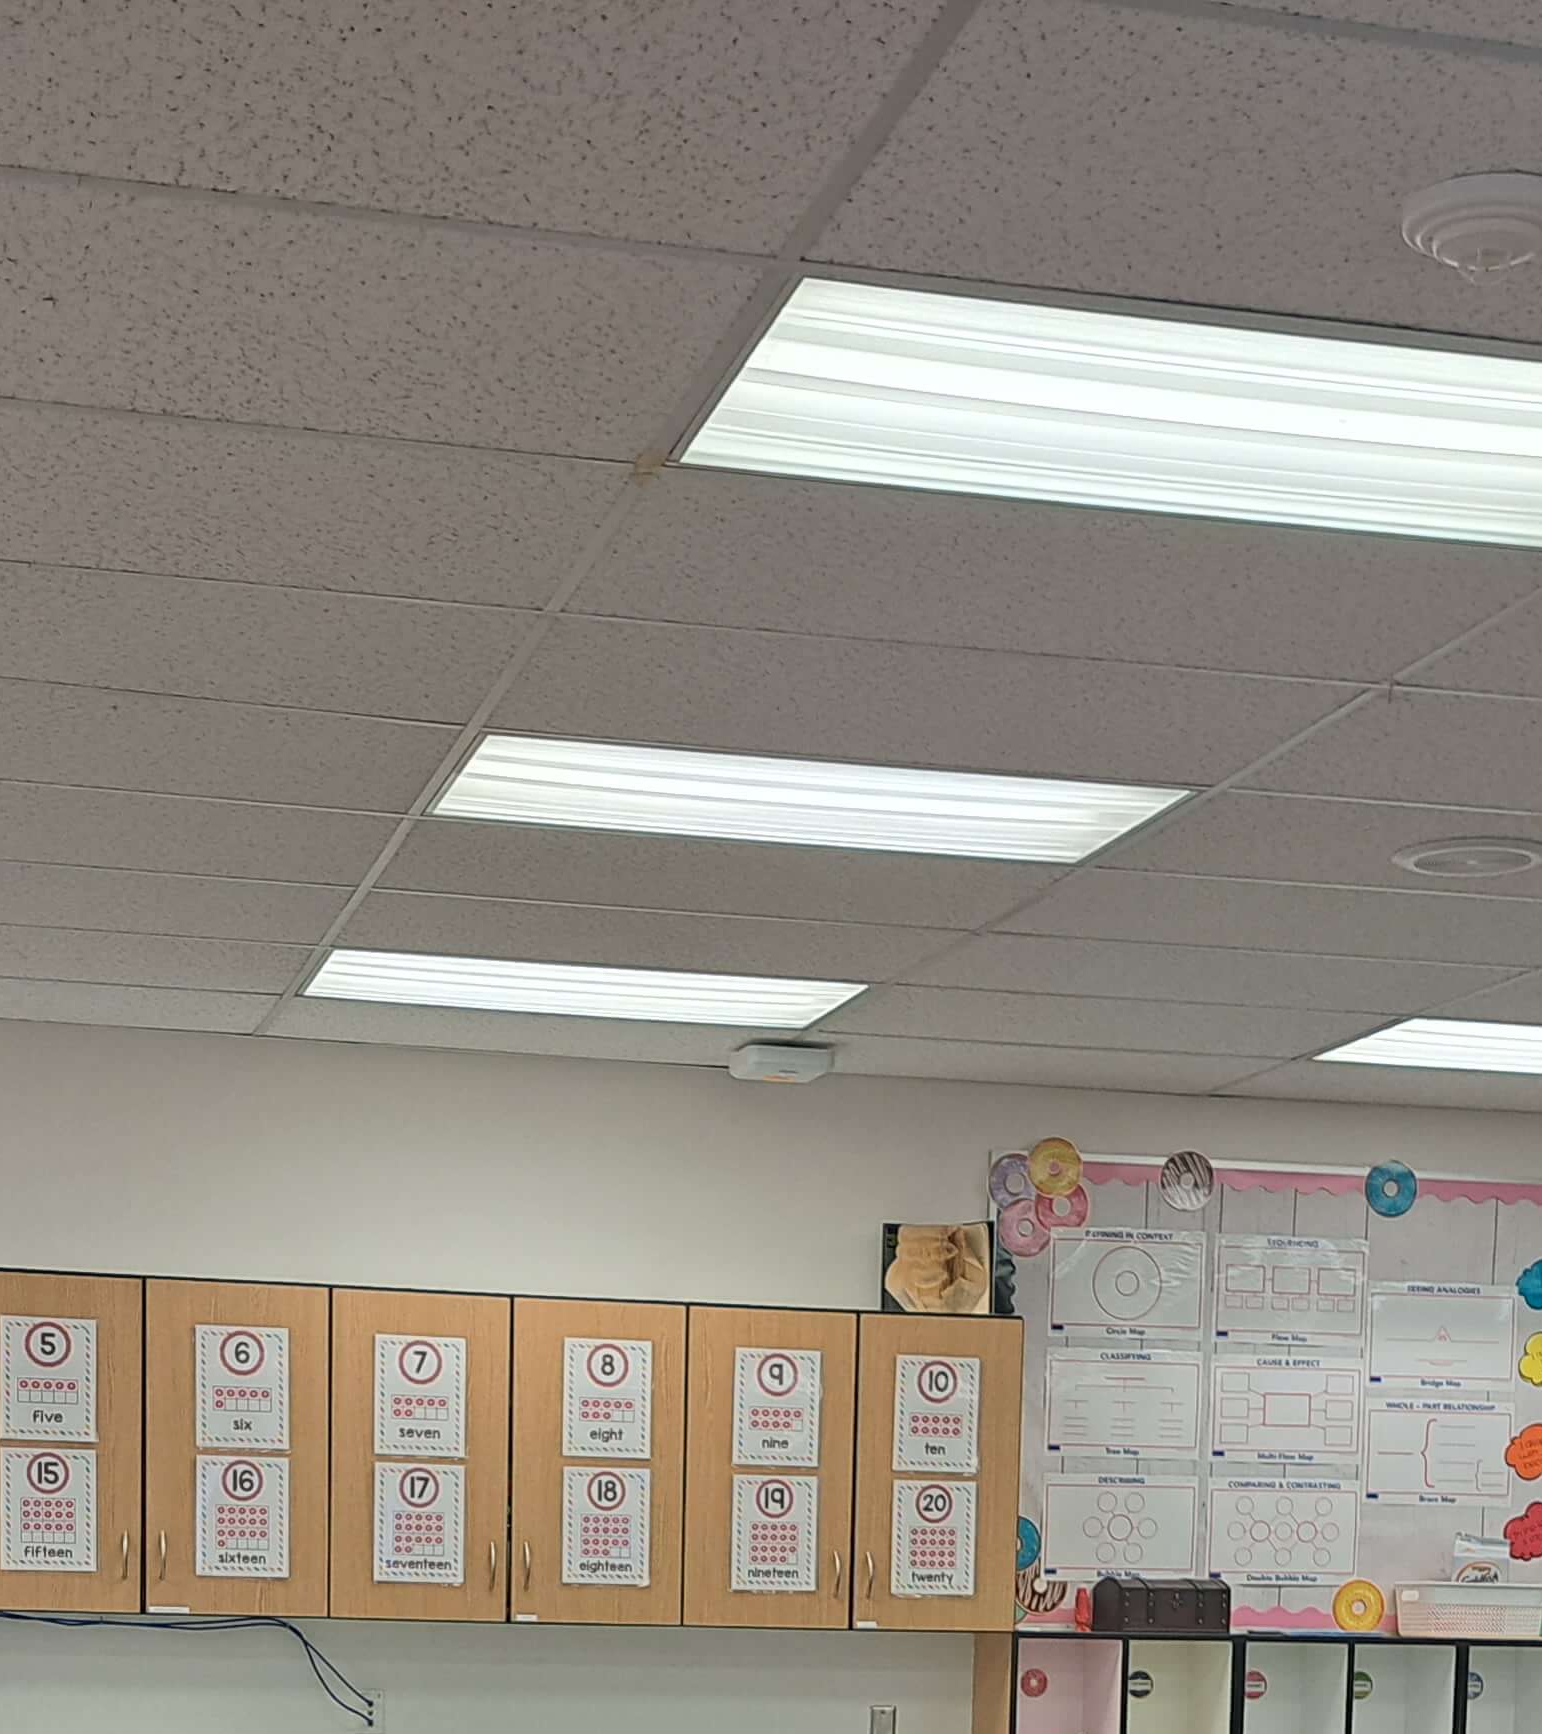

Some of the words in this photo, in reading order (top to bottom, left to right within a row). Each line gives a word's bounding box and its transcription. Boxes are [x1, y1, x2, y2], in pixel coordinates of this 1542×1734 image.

[1137, 1233, 1173, 1241] CONTEXT
[1129, 1328, 1146, 1336] Map
[40, 1332, 57, 1356] 5
[234, 1342, 250, 1364] 6
[1100, 1353, 1151, 1361] CLASSIFYING
[413, 1351, 427, 1374] 7
[601, 1354, 615, 1376] 8
[1294, 1360, 1320, 1368] EFFECT
[769, 1364, 784, 1386] 9
[928, 1371, 950, 1393] 10
[1422, 1403, 1441, 1411] PART
[32, 1410, 64, 1424] five
[233, 1418, 252, 1431] six
[398, 1427, 440, 1440] seven
[589, 1428, 624, 1443] eight
[761, 1438, 789, 1451] nine
[924, 1442, 946, 1457] ten
[37, 1462, 59, 1485] 15
[231, 1469, 254, 1492] 16
[409, 1476, 430, 1498] 17
[597, 1481, 617, 1503] 18
[1228, 1481, 1276, 1489] COMPARING
[1287, 1482, 1341, 1490] CONTRASTING
[764, 1488, 785, 1510] 19
[922, 1494, 946, 1514] 20
[24, 1546, 73, 1560] fifteen
[218, 1551, 266, 1565] sixteen
[385, 1557, 452, 1571] seventeen
[579, 1560, 633, 1575] eighteen
[747, 1567, 799, 1581] nineteen
[911, 1572, 954, 1586] twenty
